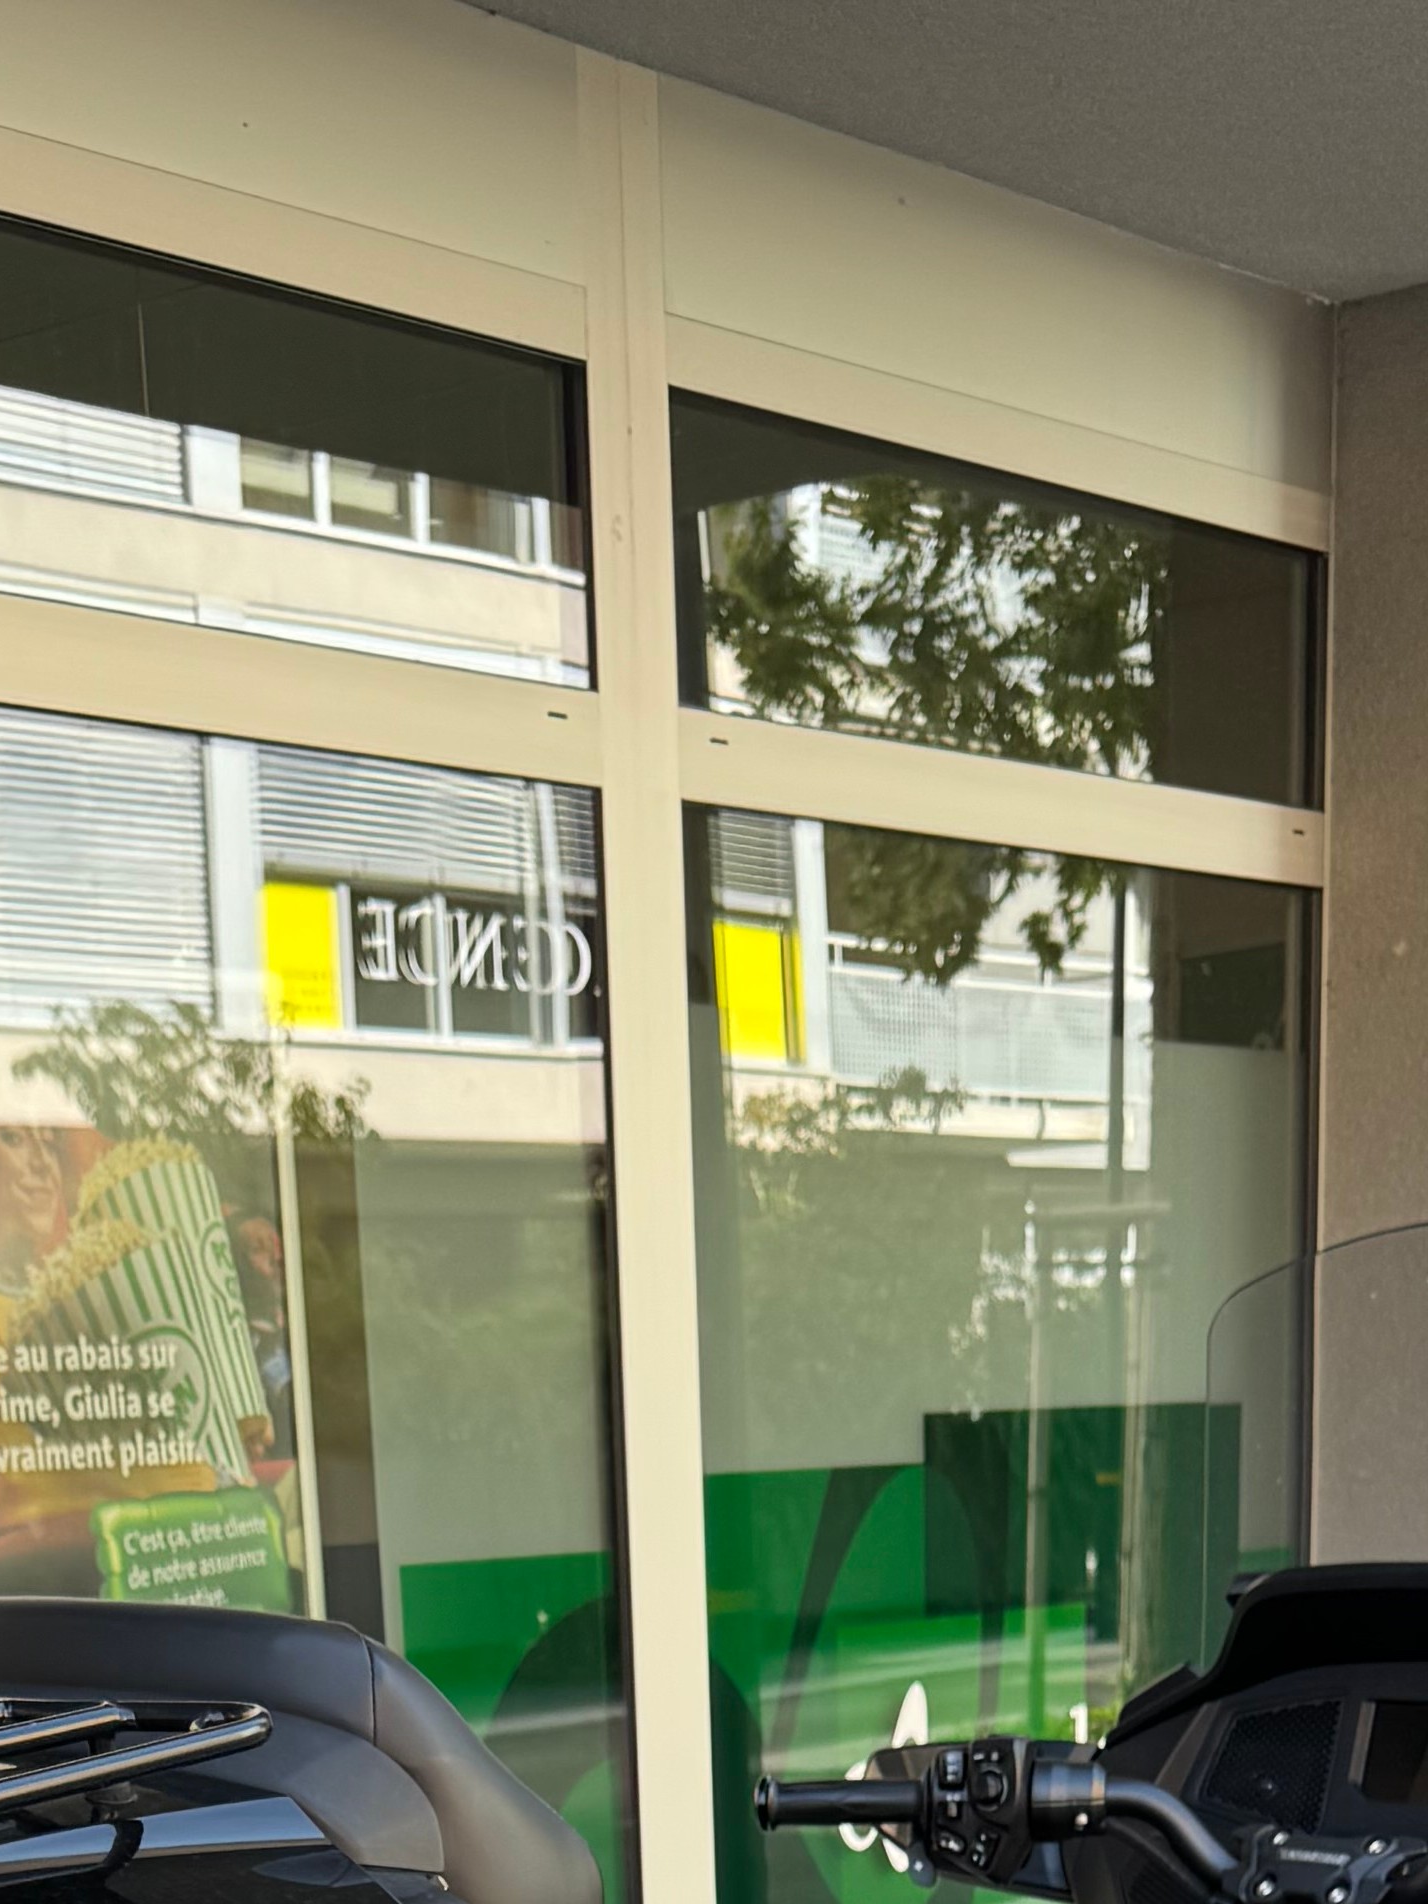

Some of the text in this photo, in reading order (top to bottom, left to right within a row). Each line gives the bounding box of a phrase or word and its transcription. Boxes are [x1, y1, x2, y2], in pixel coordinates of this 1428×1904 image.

[14, 1343, 48, 1372] au
[54, 1333, 133, 1372] rabais
[139, 1341, 177, 1371] sur
[64, 1383, 142, 1421] Giulia
[147, 1389, 174, 1419] se
[121, 1429, 203, 1478] plaisir.
[128, 1563, 150, 1590] de
[152, 1557, 197, 1586] notre
